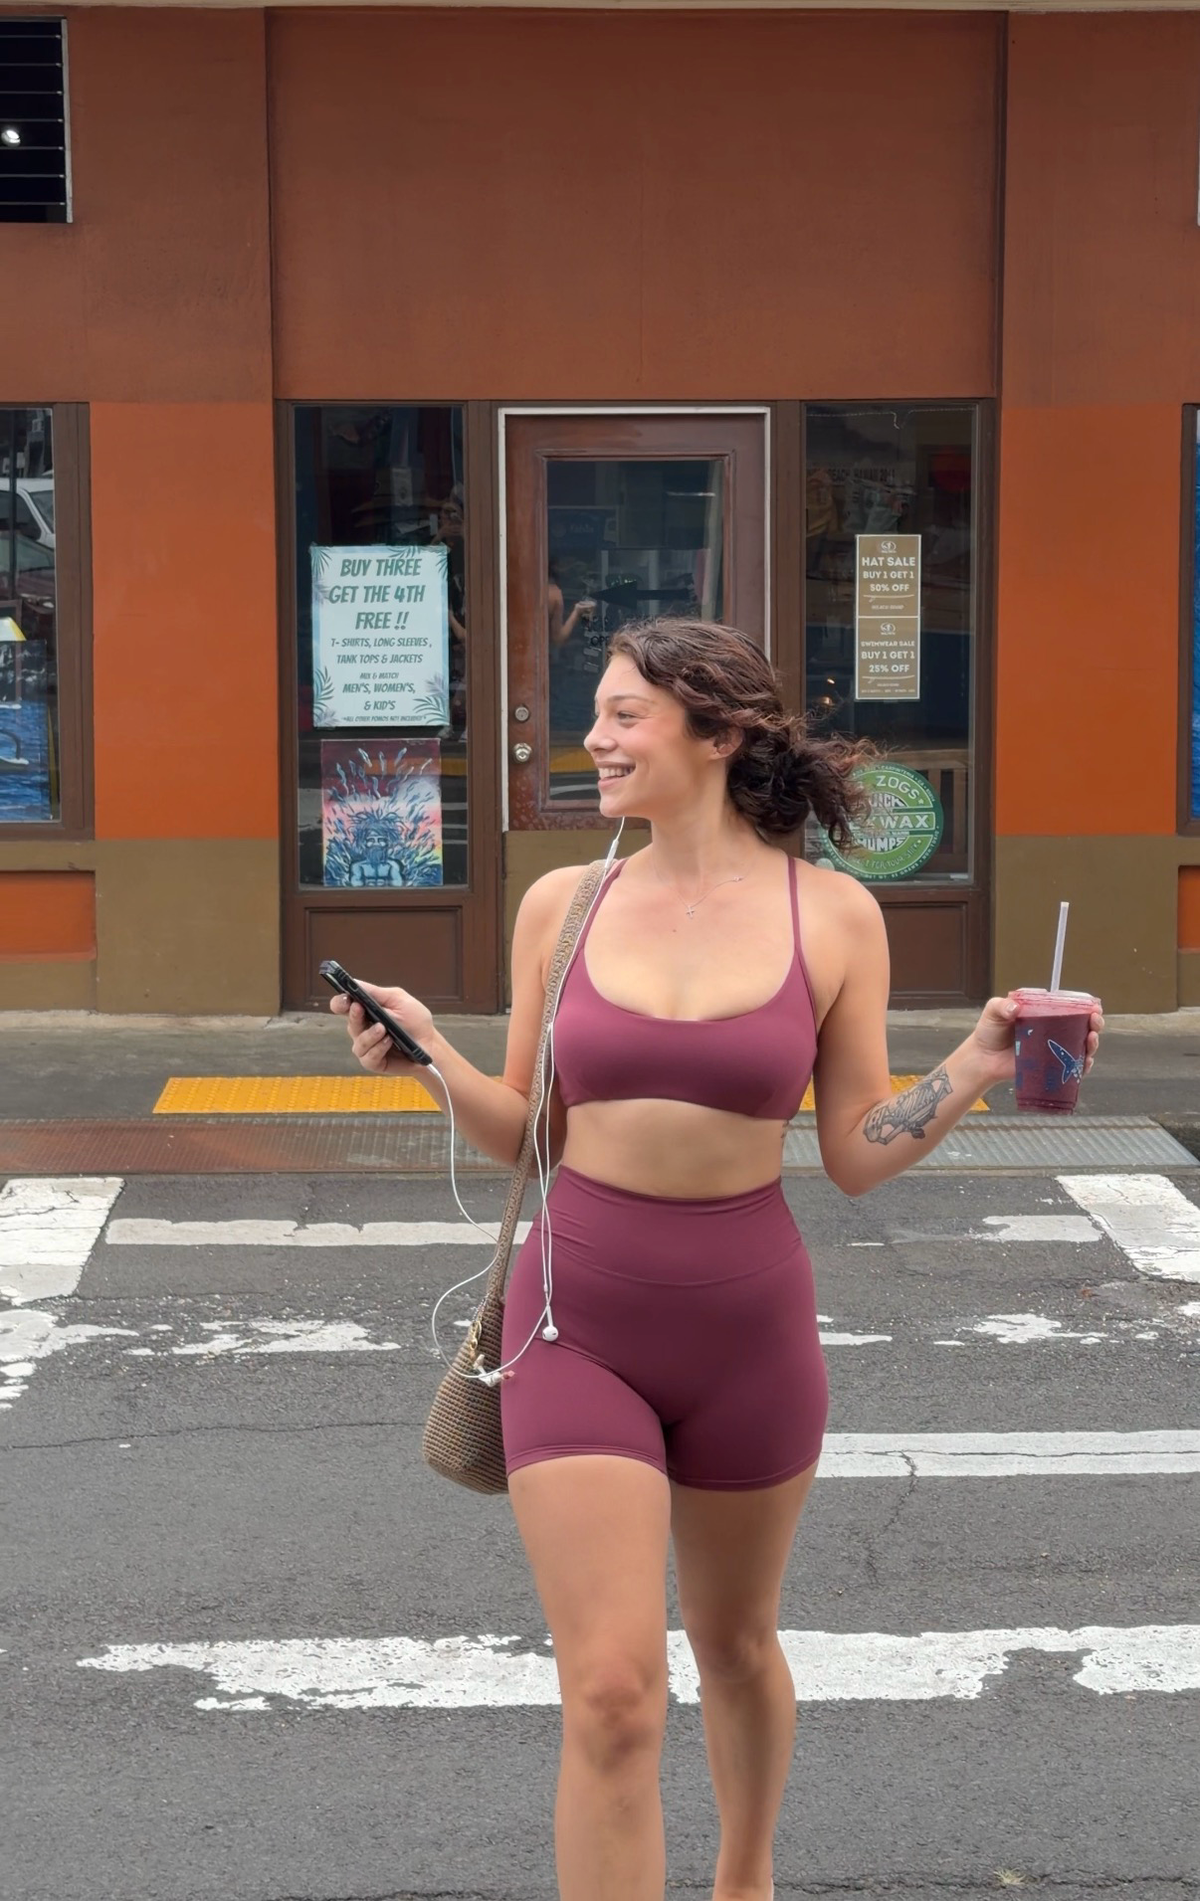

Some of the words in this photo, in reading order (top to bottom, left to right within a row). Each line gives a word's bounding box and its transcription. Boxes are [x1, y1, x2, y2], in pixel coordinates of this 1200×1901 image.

[862, 557, 884, 566] HAT
[887, 557, 916, 566] SALE
[340, 559, 371, 577] BUY
[376, 558, 422, 576] THREE
[863, 571, 881, 579] BUY
[883, 571, 888, 579] 1
[890, 571, 908, 579] GET
[909, 571, 914, 579] 1
[869, 583, 890, 592] 50%
[891, 583, 910, 592] OFF
[328, 585, 359, 604] GET
[363, 585, 391, 603] THE
[394, 585, 426, 603] 4TH
[355, 611, 392, 630] FREE
[394, 611, 409, 630] !!
[331, 638, 340, 647] T-
[341, 638, 372, 648] SHIRTS,
[373, 638, 397, 647] LONG
[337, 654, 358, 664] TANK
[360, 654, 379, 664] TOPS
[381, 654, 388, 664] &
[389, 654, 423, 664] JACKETS
[861, 651, 880, 659] BUY
[882, 651, 887, 659] 1
[889, 651, 908, 659] GET
[910, 651, 915, 659] 1
[869, 664, 889, 673] 25%
[891, 664, 910, 673] OFF
[342, 683, 371, 694] MEN'S,
[373, 682, 416, 694] WOMEN'S,
[363, 700, 371, 711] &
[372, 700, 396, 710] KID'S
[876, 775, 920, 800] ZOGS
[870, 793, 906, 808] UICK
